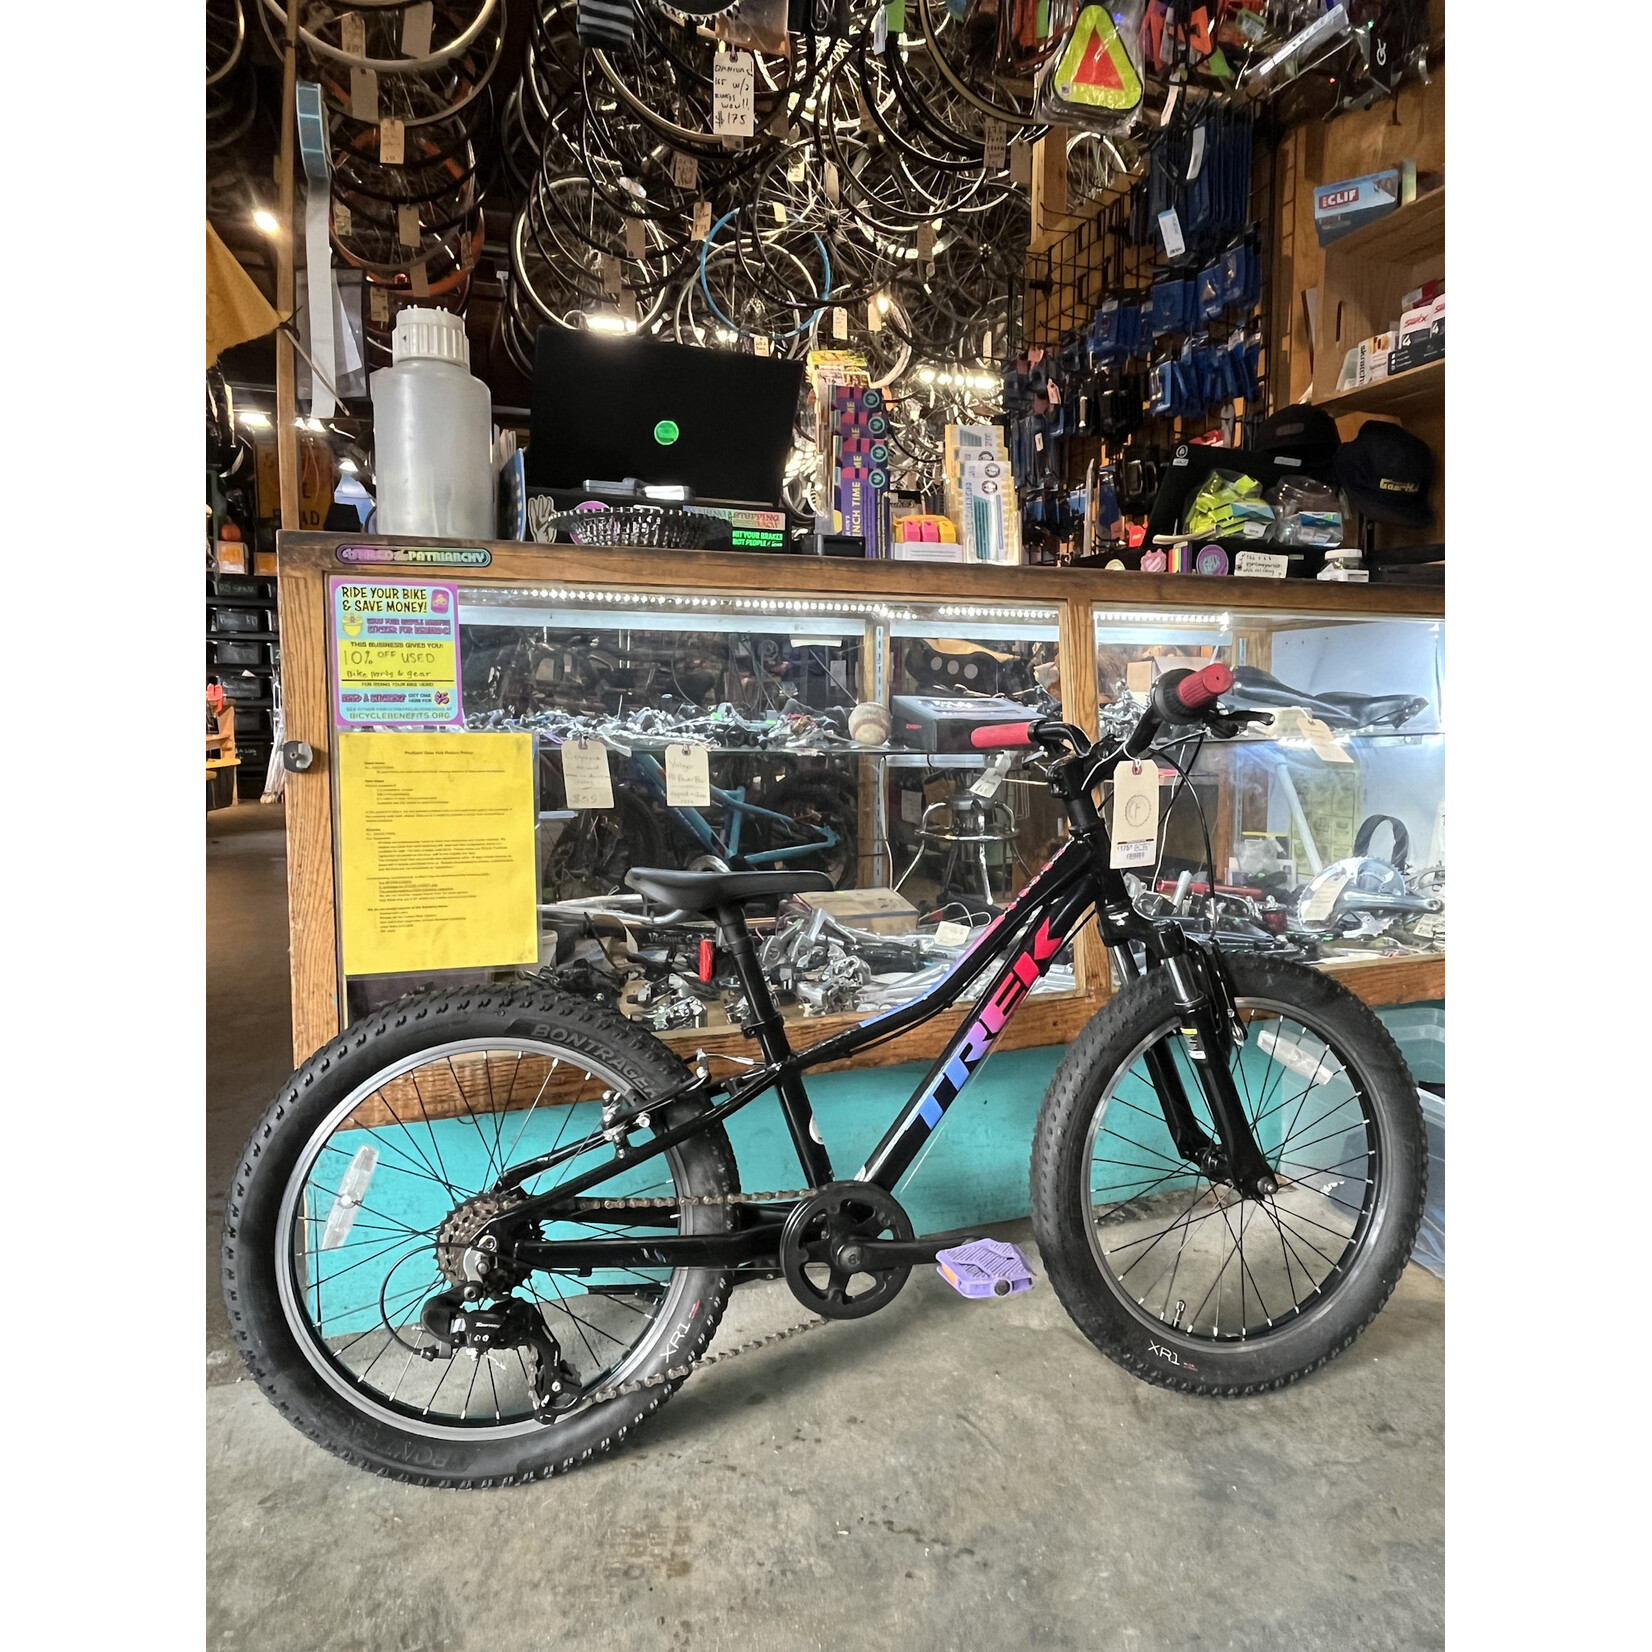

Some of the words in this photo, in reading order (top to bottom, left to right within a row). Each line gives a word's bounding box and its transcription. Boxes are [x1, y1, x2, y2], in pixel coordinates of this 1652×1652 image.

[1327, 189, 1356, 206] CLIF
[852, 481, 861, 507] TIME
[744, 531, 760, 540] YOUR
[746, 539, 766, 547] PEOPLE
[408, 550, 486, 563] PATRIARCHY
[341, 586, 367, 599] RIDE
[370, 587, 399, 599] YOUR
[402, 588, 427, 600] BIKE
[342, 600, 352, 612] &
[354, 600, 383, 612] SAVE
[386, 601, 428, 613] MONEY!
[344, 650, 373, 665] 10%
[377, 650, 397, 659] OFF
[401, 652, 435, 664] USED
[406, 671, 432, 679] gear
[905, 916, 1064, 1131] TREK
[659, 1322, 691, 1363] XR1
[1147, 1339, 1180, 1366] XR1
